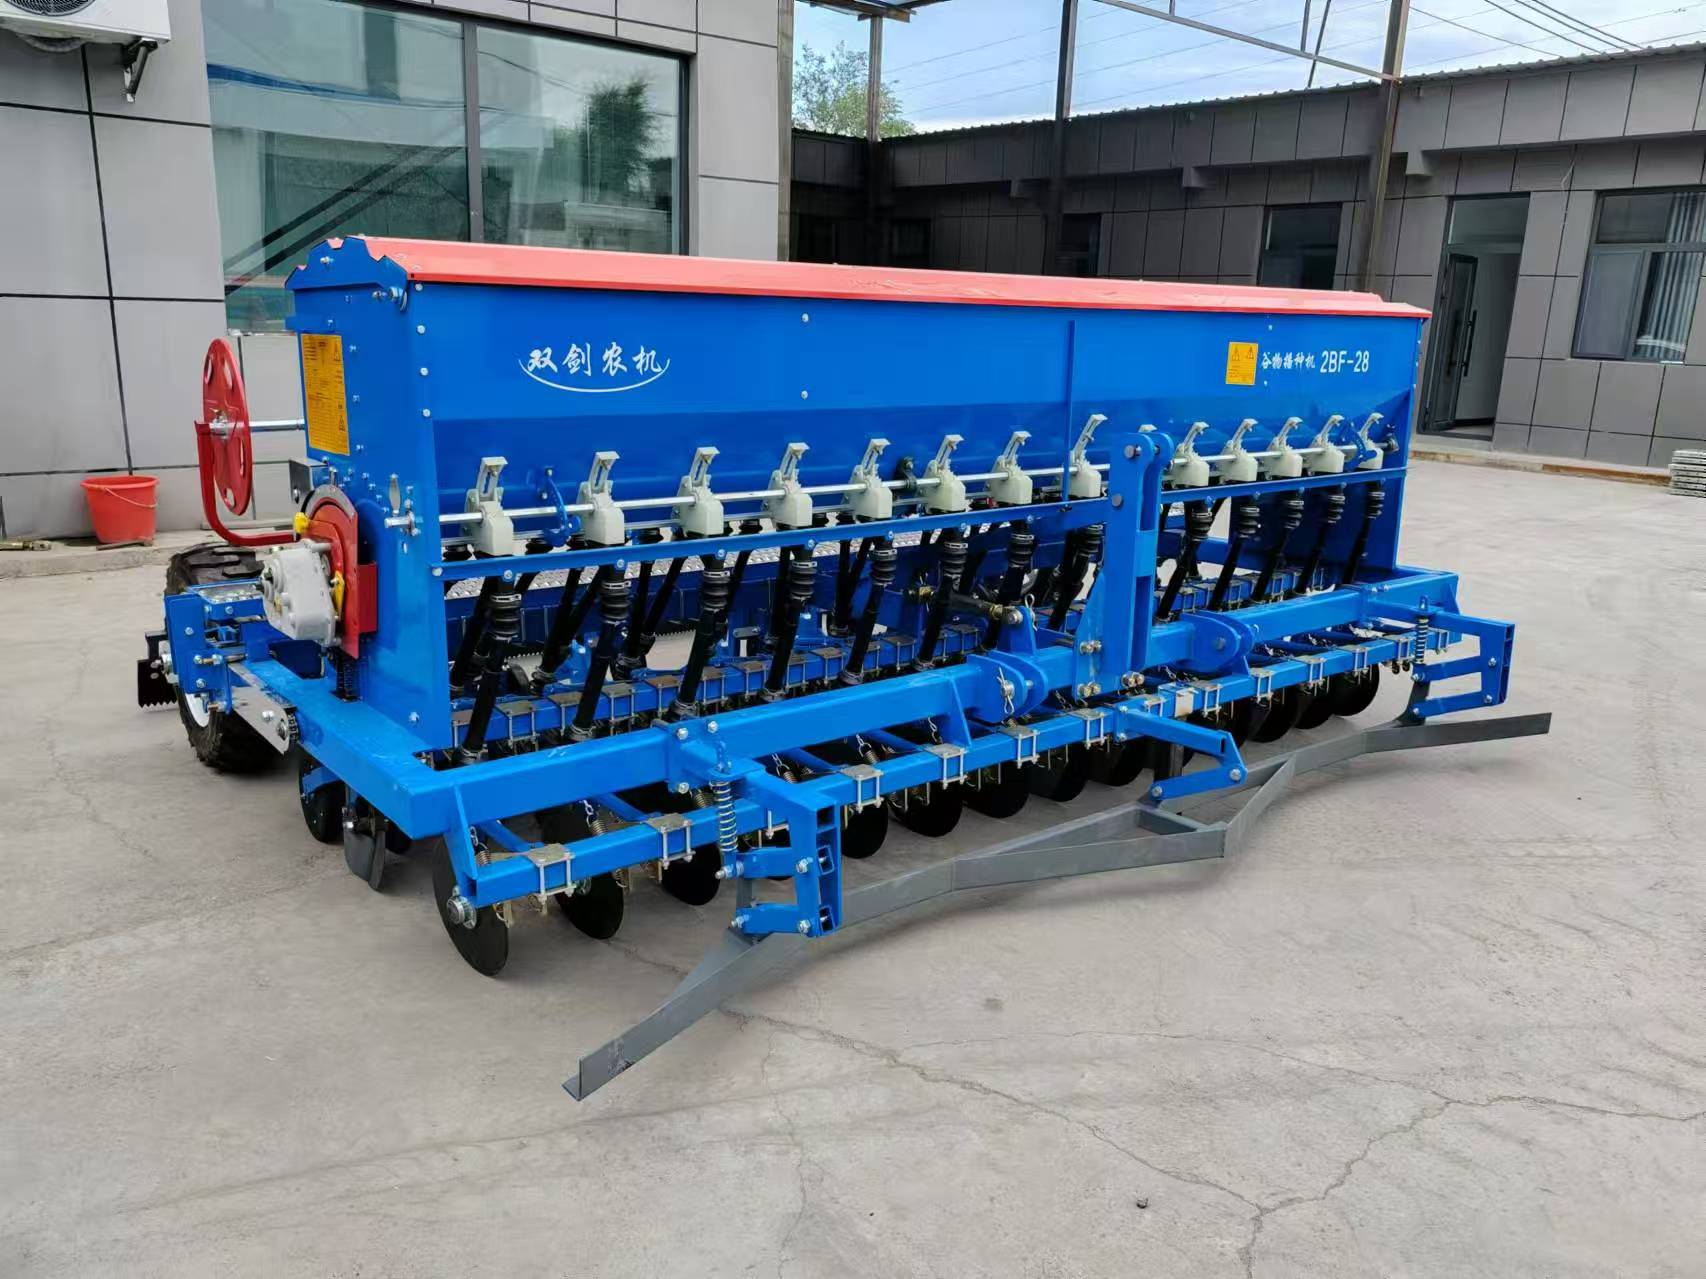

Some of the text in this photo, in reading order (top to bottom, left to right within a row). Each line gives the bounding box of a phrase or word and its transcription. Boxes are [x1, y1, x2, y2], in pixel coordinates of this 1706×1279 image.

[527, 342, 663, 376] 双剑农机
[1261, 352, 1316, 370] 谷物播种机
[1320, 350, 1370, 373] 2BF-28
